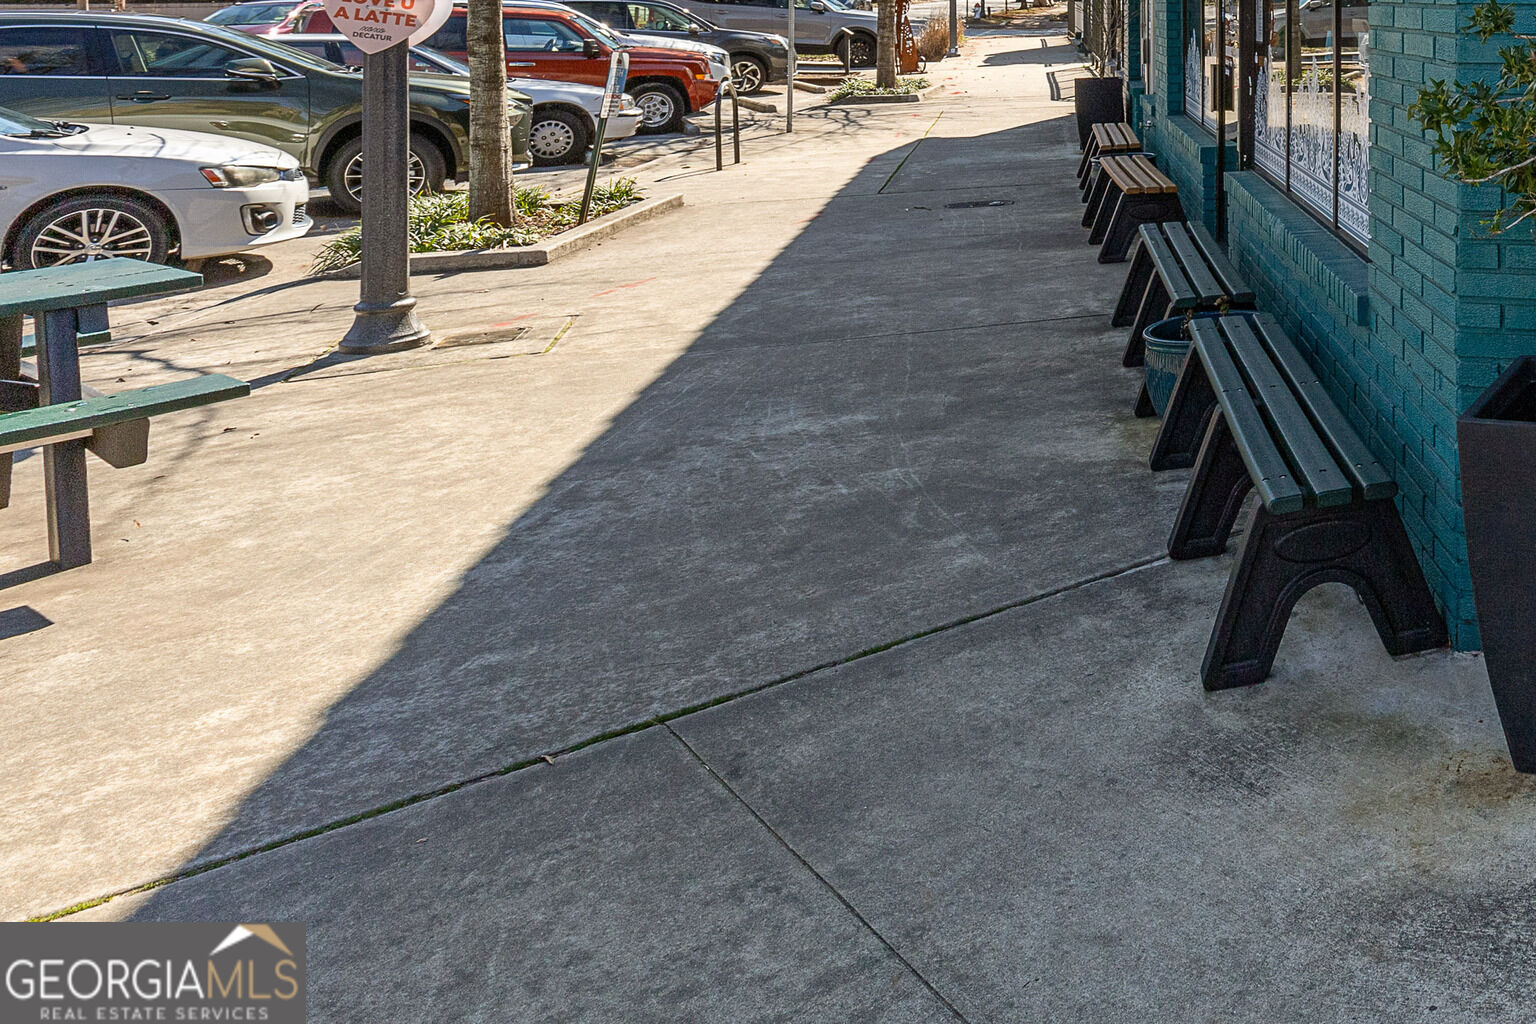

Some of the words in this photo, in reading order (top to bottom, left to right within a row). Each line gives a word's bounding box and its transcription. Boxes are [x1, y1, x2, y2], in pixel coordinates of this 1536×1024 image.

[333, 7, 350, 21] A
[354, 8, 418, 27] LATTE
[352, 31, 392, 42] DECATUR
